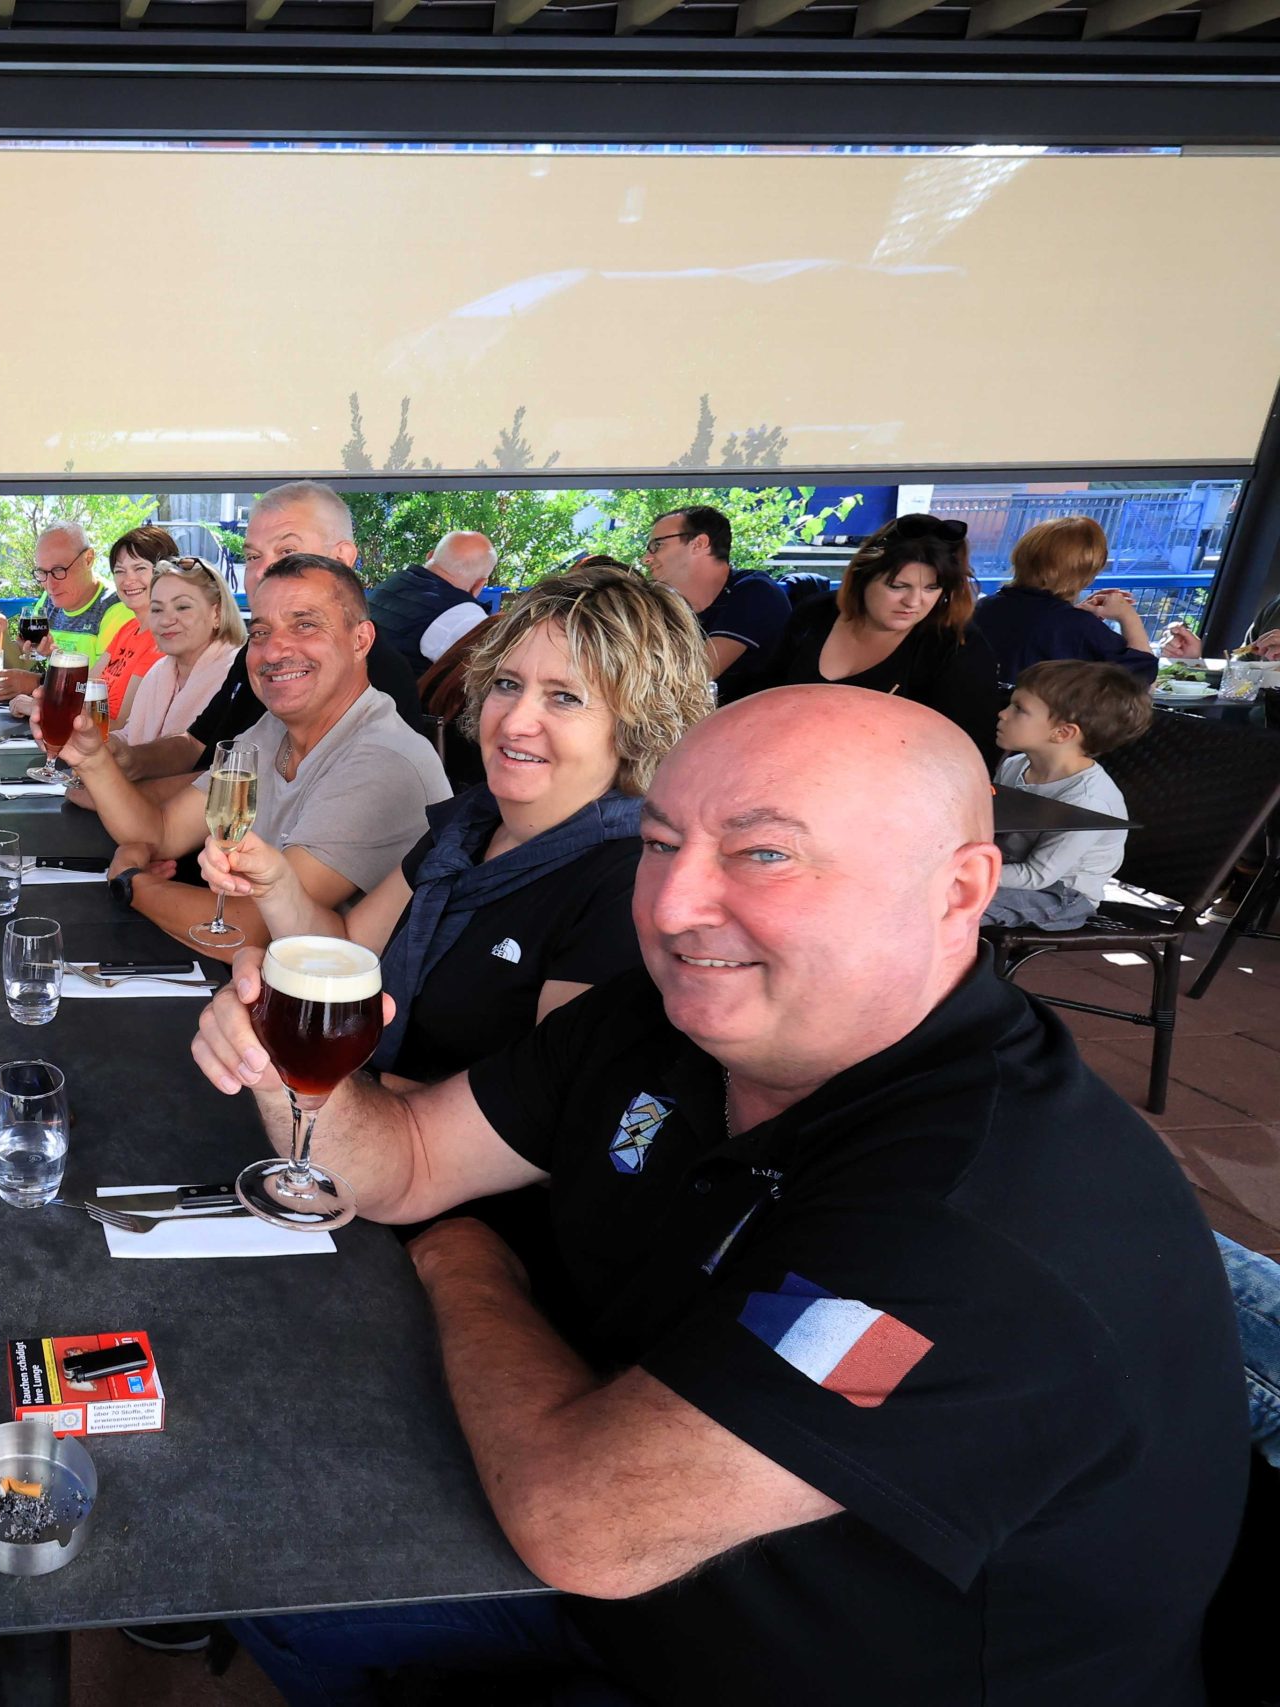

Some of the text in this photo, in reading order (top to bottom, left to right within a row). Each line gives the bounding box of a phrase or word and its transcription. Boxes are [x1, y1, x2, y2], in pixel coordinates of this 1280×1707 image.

[15, 1341, 28, 1372] schädigt
[20, 1372, 32, 1405] Rauchen
[32, 1364, 45, 1404] Ihre Lunge
